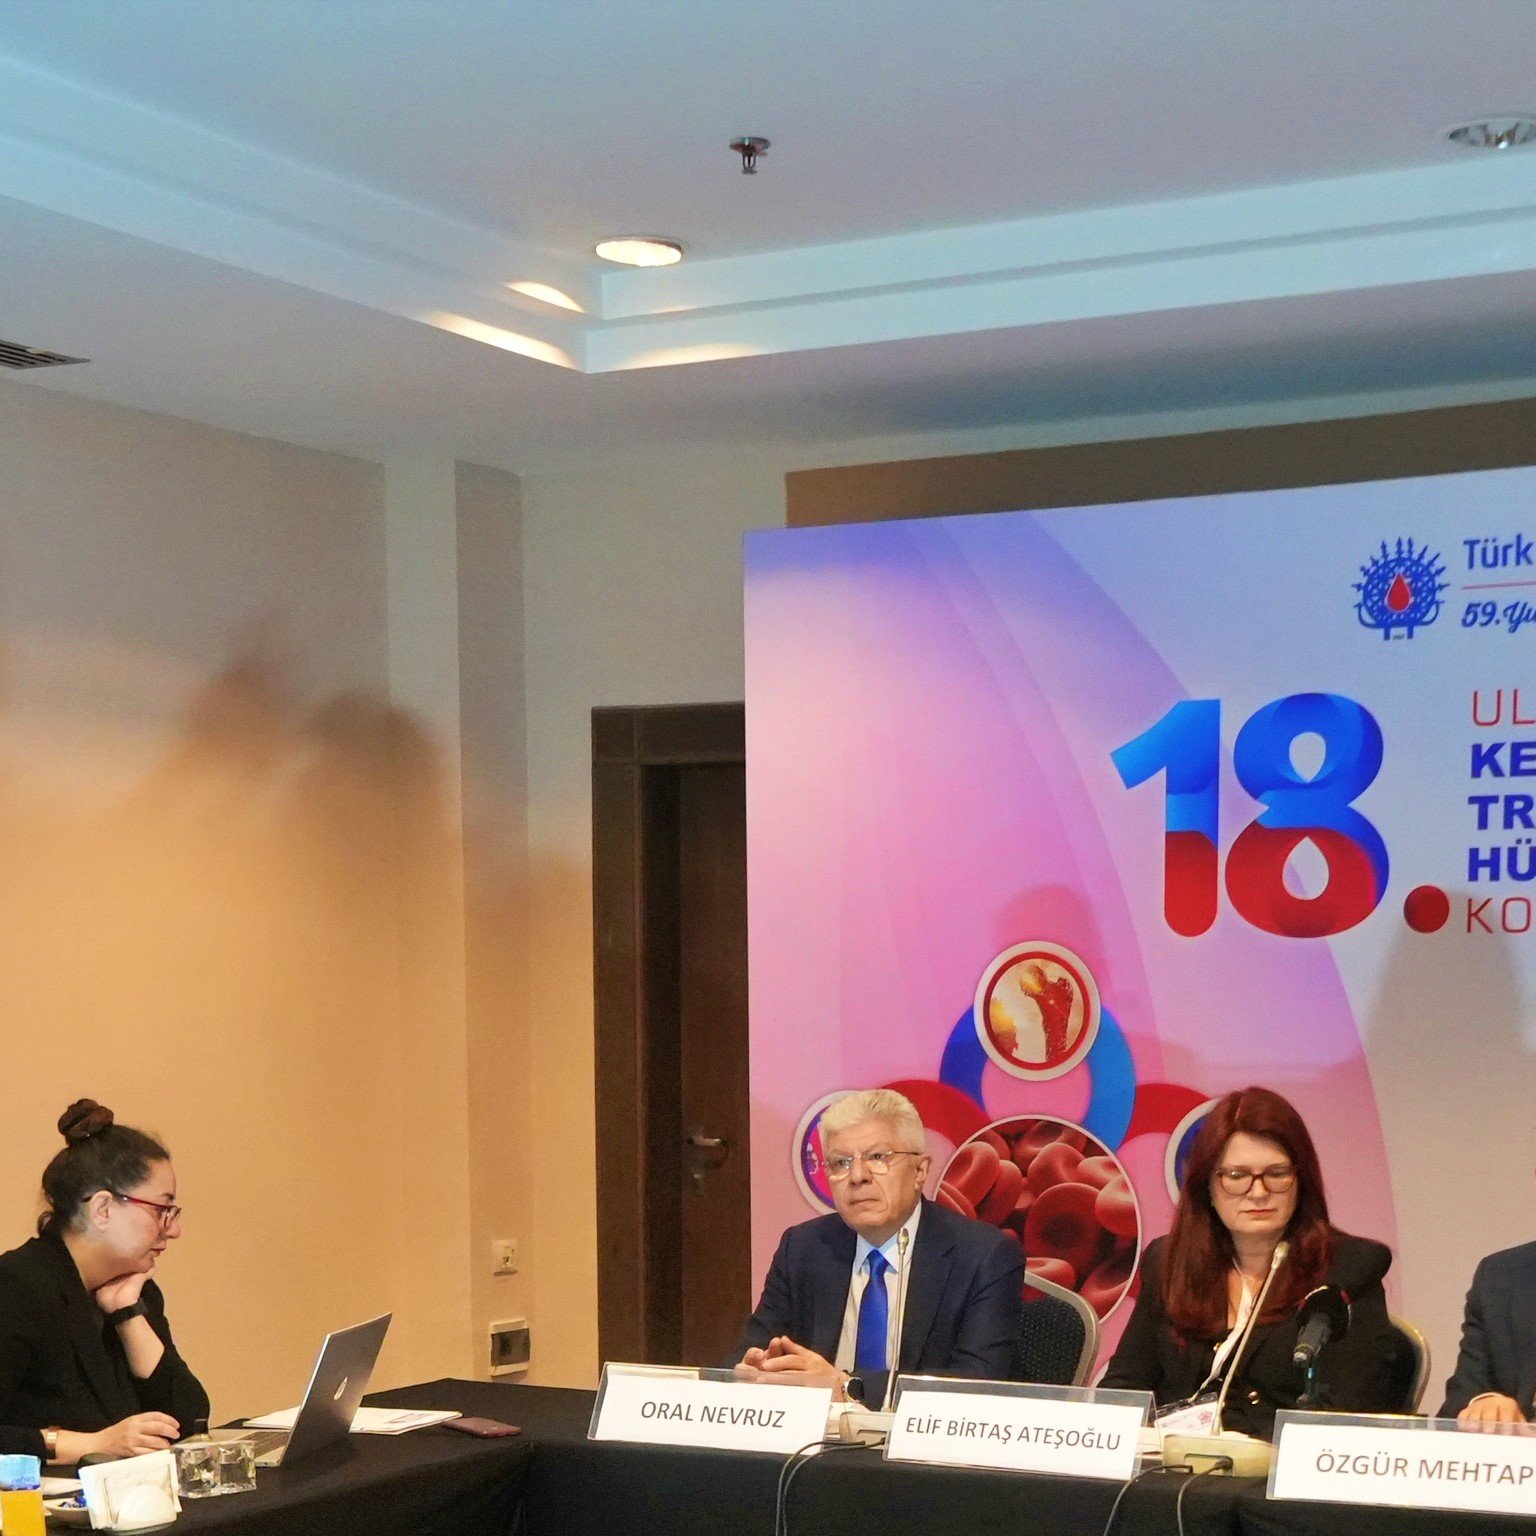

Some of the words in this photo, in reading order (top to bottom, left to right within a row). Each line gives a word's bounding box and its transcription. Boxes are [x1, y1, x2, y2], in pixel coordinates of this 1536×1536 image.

[1462, 532, 1534, 570] Türk
[1110, 692, 1450, 939] 18.
[640, 1401, 694, 1422] ORAL
[699, 1405, 786, 1429] NEVRUZ
[905, 1414, 942, 1435] ELİF
[946, 1416, 1013, 1445] BİRTAŞ
[1017, 1425, 1122, 1451] ATEŞOĞLU
[1315, 1448, 1409, 1478] ÖZGÜR
[1417, 1458, 1535, 1486] MEHTAP
